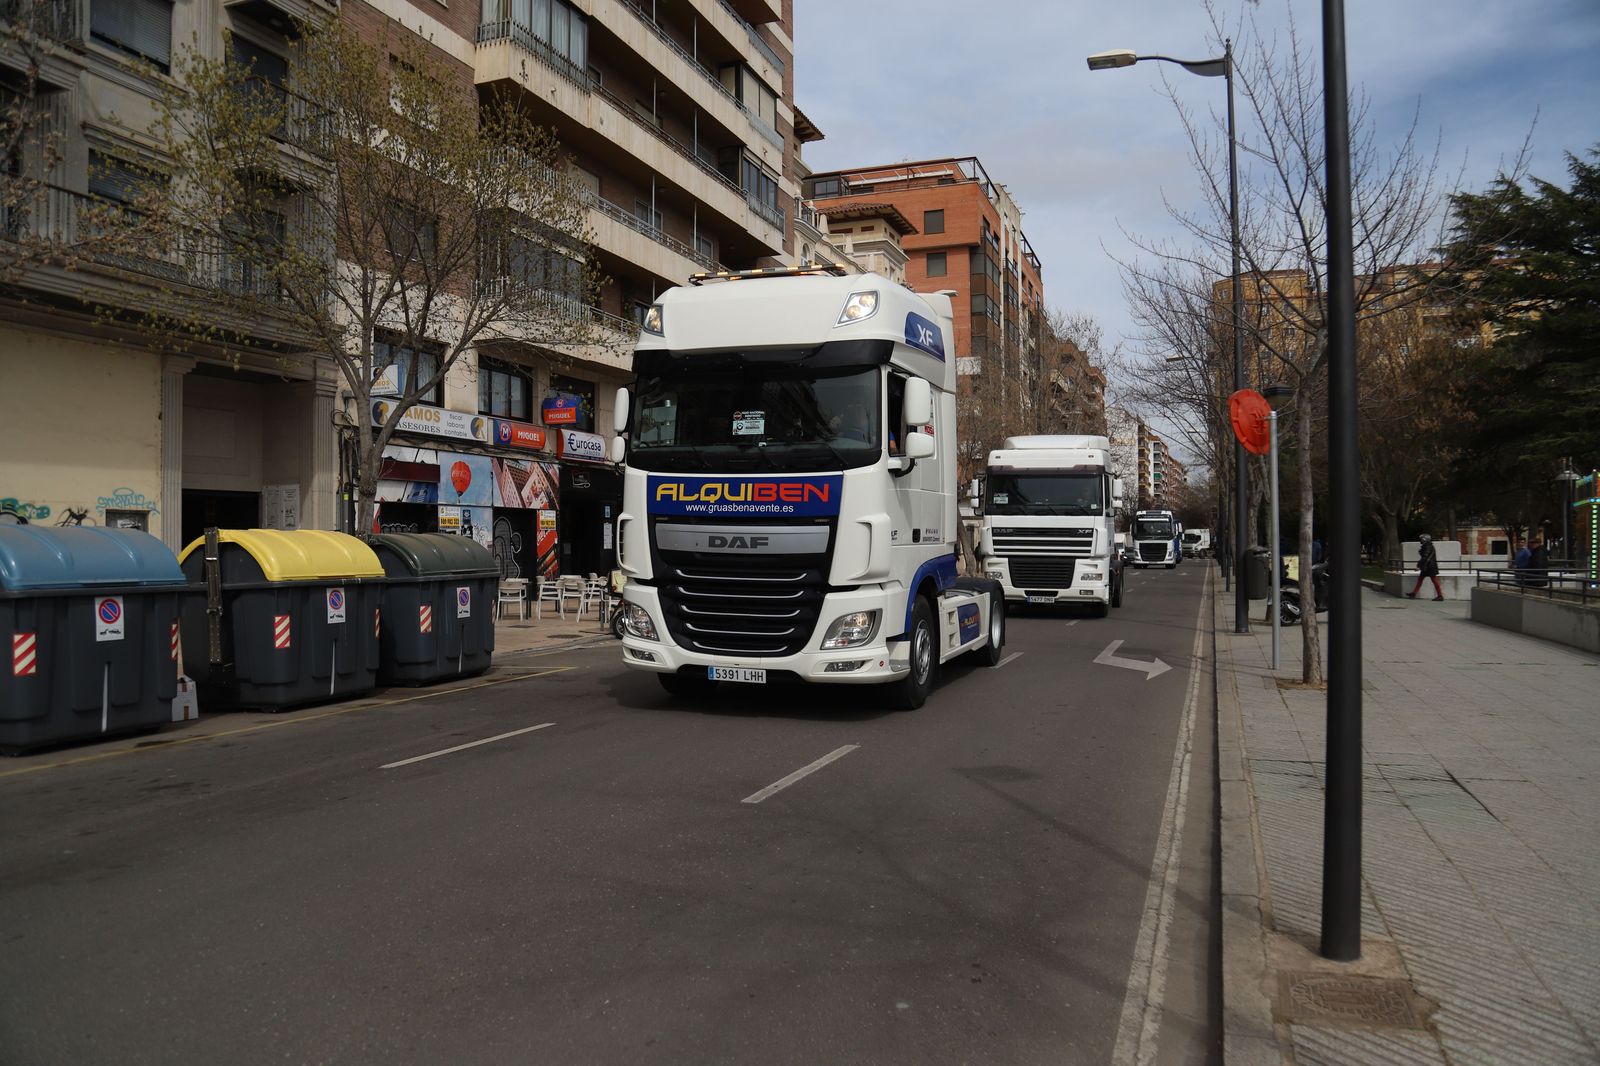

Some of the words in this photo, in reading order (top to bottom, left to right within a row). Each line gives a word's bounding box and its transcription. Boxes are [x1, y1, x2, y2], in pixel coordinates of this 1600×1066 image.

[917, 323, 933, 347] XF
[405, 407, 441, 423] AMOS
[446, 421, 466, 429] laboral
[444, 429, 467, 437] contable
[518, 431, 540, 442] MIGUEL
[656, 483, 829, 503] ALQUIBEN
[685, 503, 794, 513] www.gruasbenavente.es
[708, 536, 769, 549] DAF
[715, 669, 739, 680] 5391
[743, 670, 764, 682] LHH
